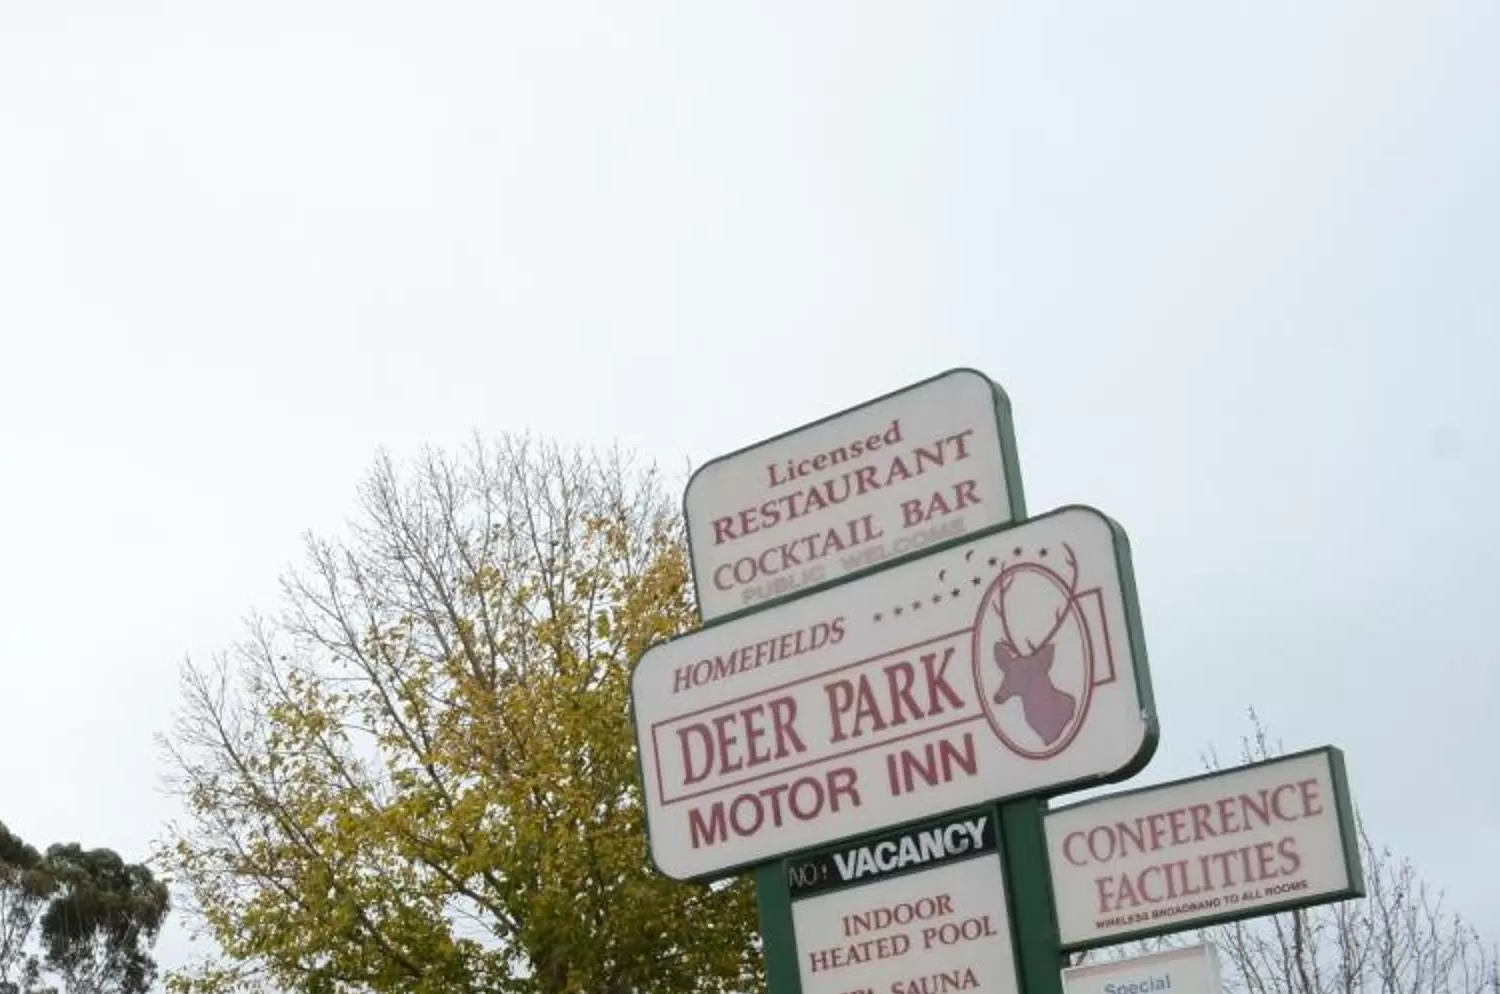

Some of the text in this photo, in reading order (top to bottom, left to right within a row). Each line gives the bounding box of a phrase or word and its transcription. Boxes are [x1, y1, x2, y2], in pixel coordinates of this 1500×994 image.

[711, 429, 974, 545] RESTAURANT
[768, 419, 903, 488] Licensed
[713, 479, 982, 591] COCKTAIL BAR
[672, 617, 845, 694] HOMEFIELDS
[676, 647, 964, 786] DEER PARK
[689, 733, 978, 849] MOTOR INN
[1062, 778, 1323, 867] CONFERENCE
[833, 817, 987, 881] VACANCY
[1094, 837, 1300, 914] FACILITIES
[842, 893, 954, 937] INDOOR
[1096, 880, 1309, 929] WIRELESS BROADBAND TO ALL ROOMS
[809, 916, 997, 973] HEATED POOL
